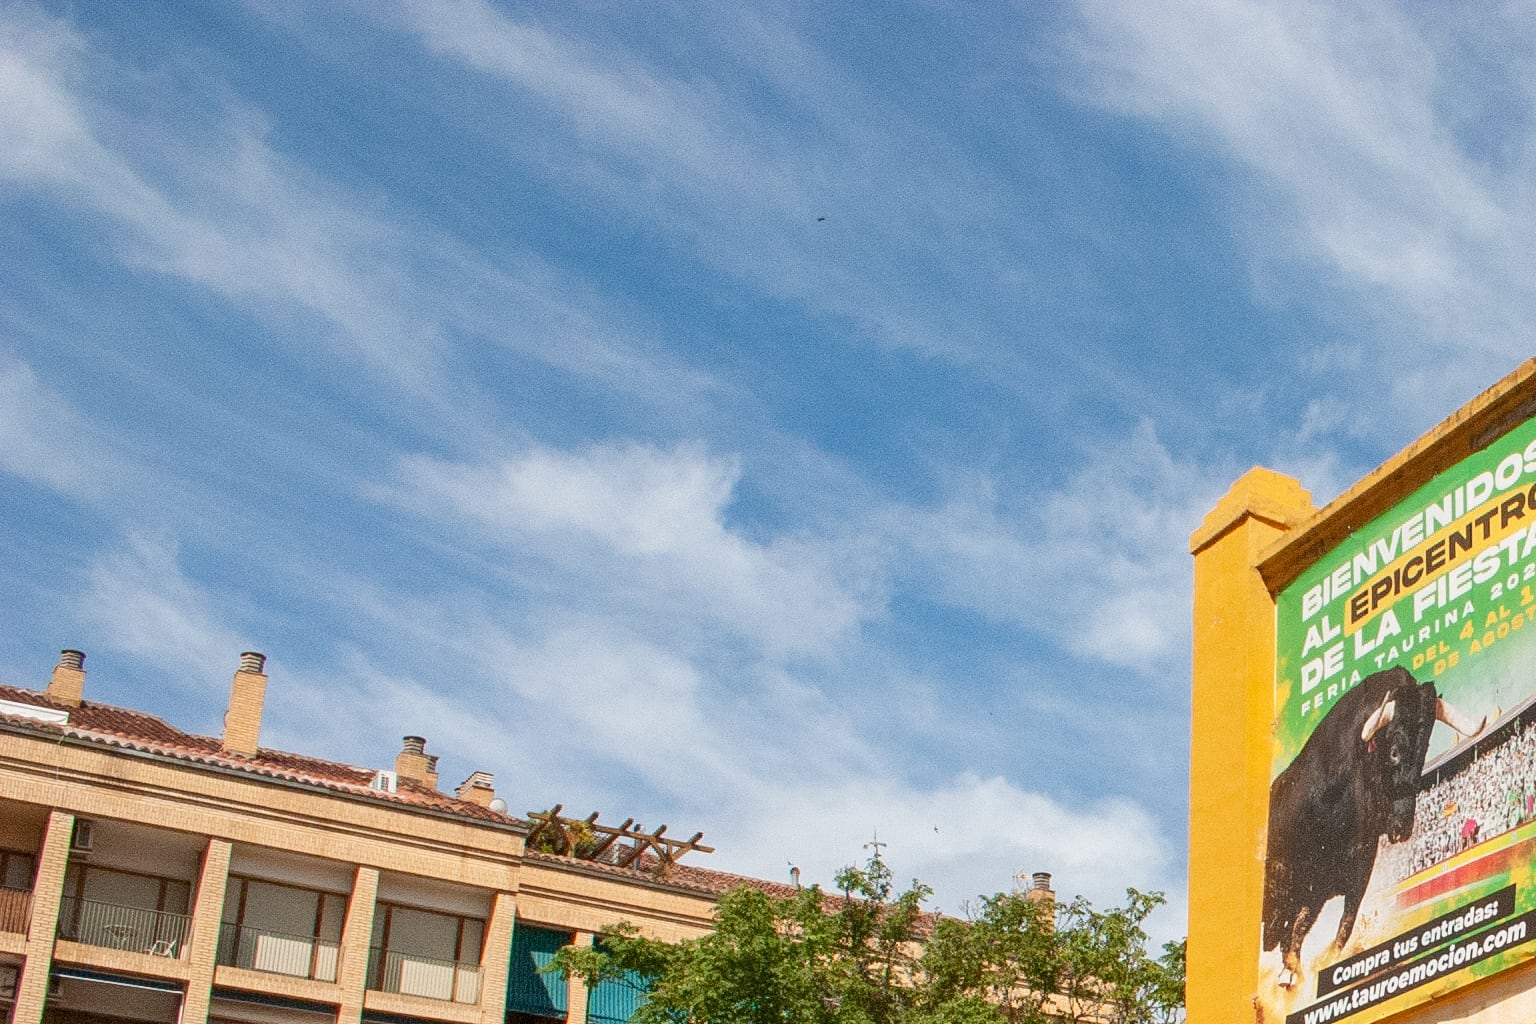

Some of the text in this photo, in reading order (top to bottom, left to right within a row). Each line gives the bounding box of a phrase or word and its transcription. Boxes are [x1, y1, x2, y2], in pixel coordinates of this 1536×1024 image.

[1301, 615, 1342, 659] AL
[1301, 641, 1344, 695] DE
[1354, 609, 1402, 660] LA
[1301, 670, 1361, 717] FERIA
[1374, 600, 1475, 669] TAURINA
[1412, 640, 1450, 671] DEL
[1459, 619, 1475, 640] 4
[1485, 604, 1511, 628] AL
[1433, 650, 1460, 677] DE
[1331, 899, 1499, 986] Compra tus entradas:
